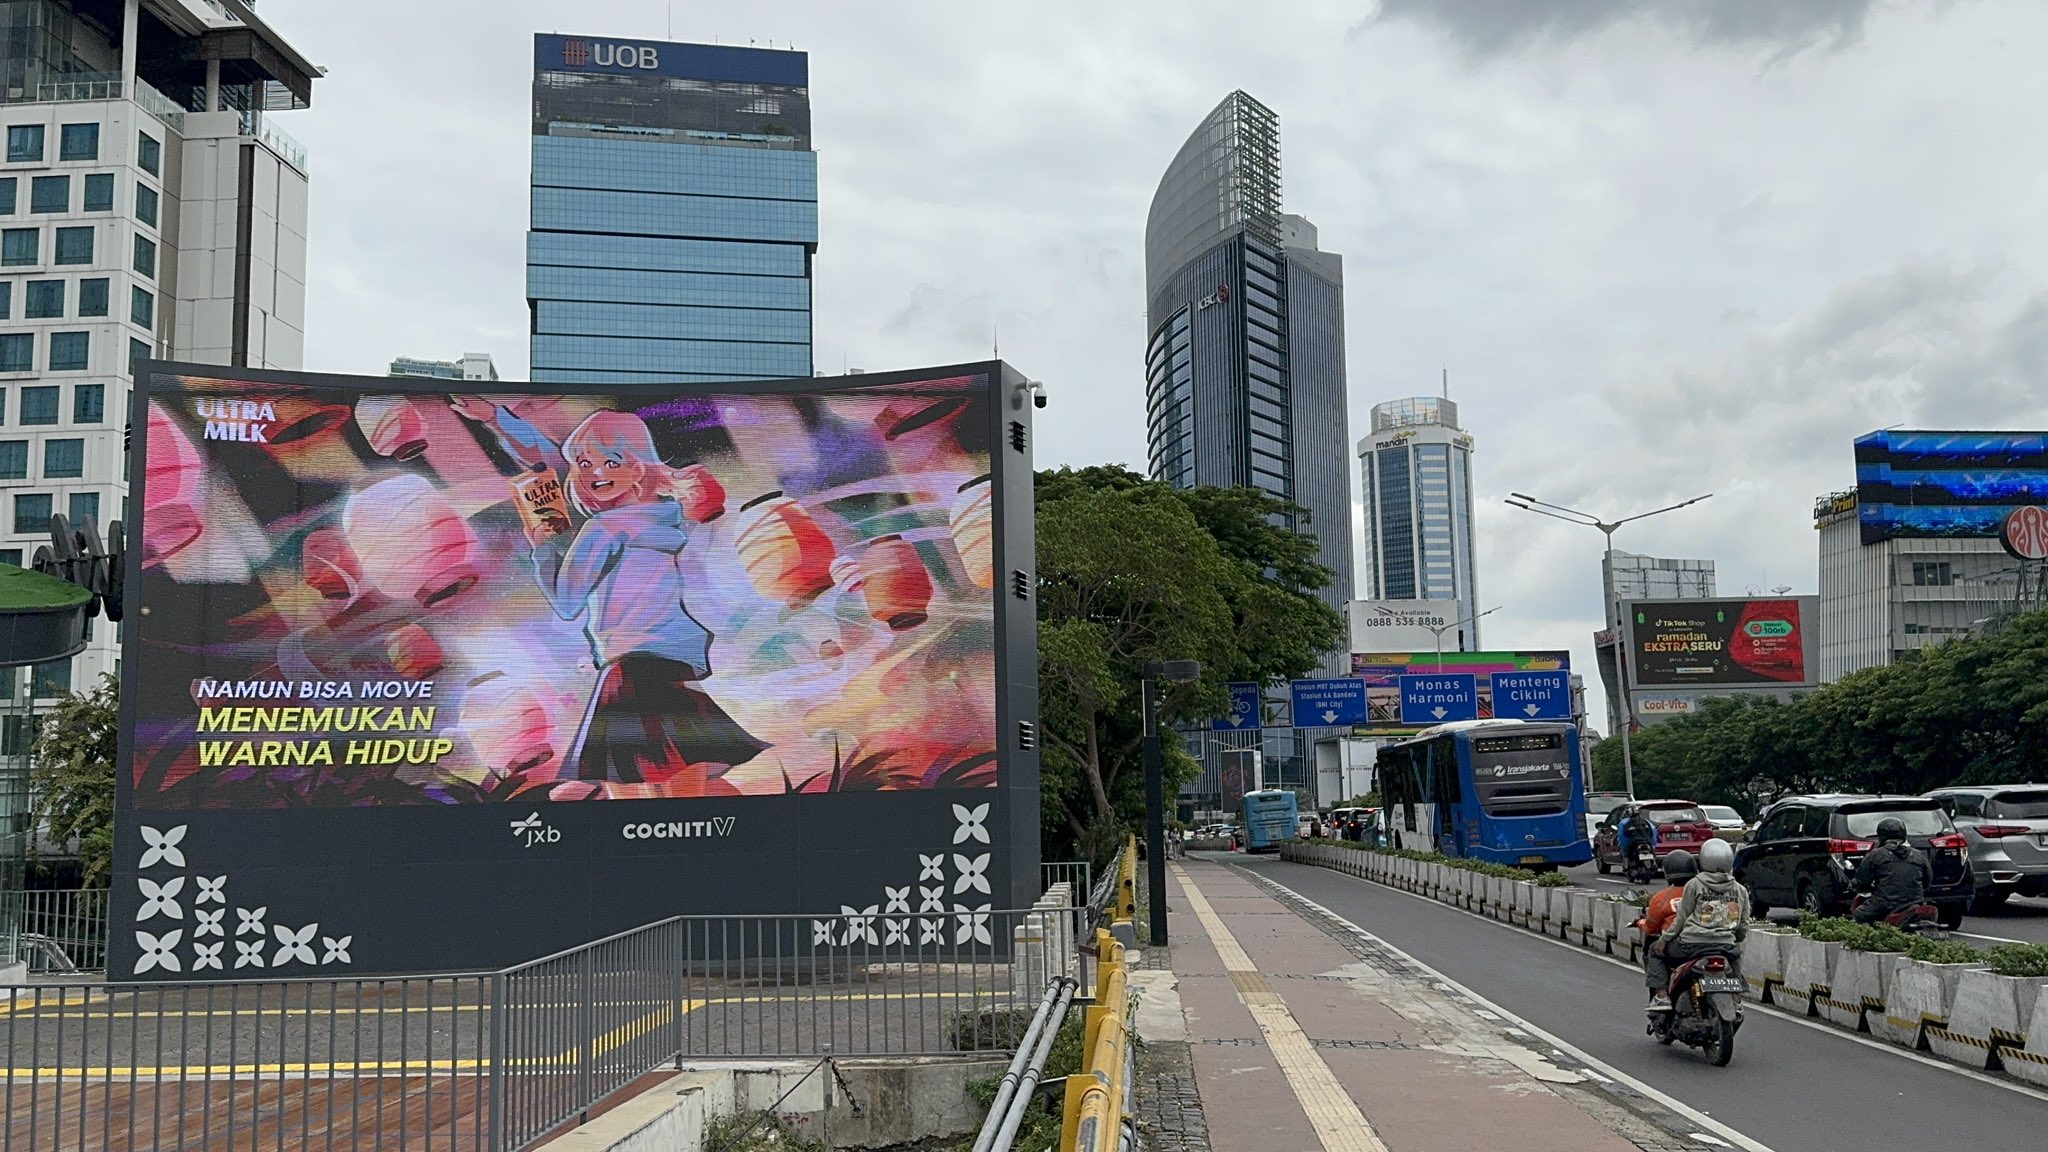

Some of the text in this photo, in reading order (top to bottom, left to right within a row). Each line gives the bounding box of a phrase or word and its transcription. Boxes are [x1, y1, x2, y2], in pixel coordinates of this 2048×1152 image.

[594, 43, 659, 69] UOB
[196, 397, 276, 421] ULTRA
[204, 420, 268, 443] MILK
[524, 479, 560, 502] ULTRA
[533, 491, 560, 508] MILK
[1366, 617, 1392, 627] 0888
[1688, 620, 1706, 628] Shop
[1656, 631, 1708, 641] ramadan
[1763, 627, 1787, 635] 100rb
[1644, 640, 1722, 652] EKSTRA SERU
[197, 680, 434, 699] NAMUN BISA MOVE
[1329, 682, 1348, 690] Dukuh
[1415, 679, 1461, 691] Monas
[1499, 676, 1561, 690] Menteng
[1300, 692, 1322, 700] Stasiun
[1332, 691, 1357, 699] Bandara
[1408, 691, 1468, 704] Harmoni
[1511, 688, 1551, 701] Cikini
[1644, 698, 1688, 710] Cool-Vita
[196, 706, 436, 733] MENEMUKAN
[198, 738, 454, 767] WARNA HIDUP
[1507, 763, 1550, 776] transjakarta
[524, 816, 736, 848] jxb COGNITIV
